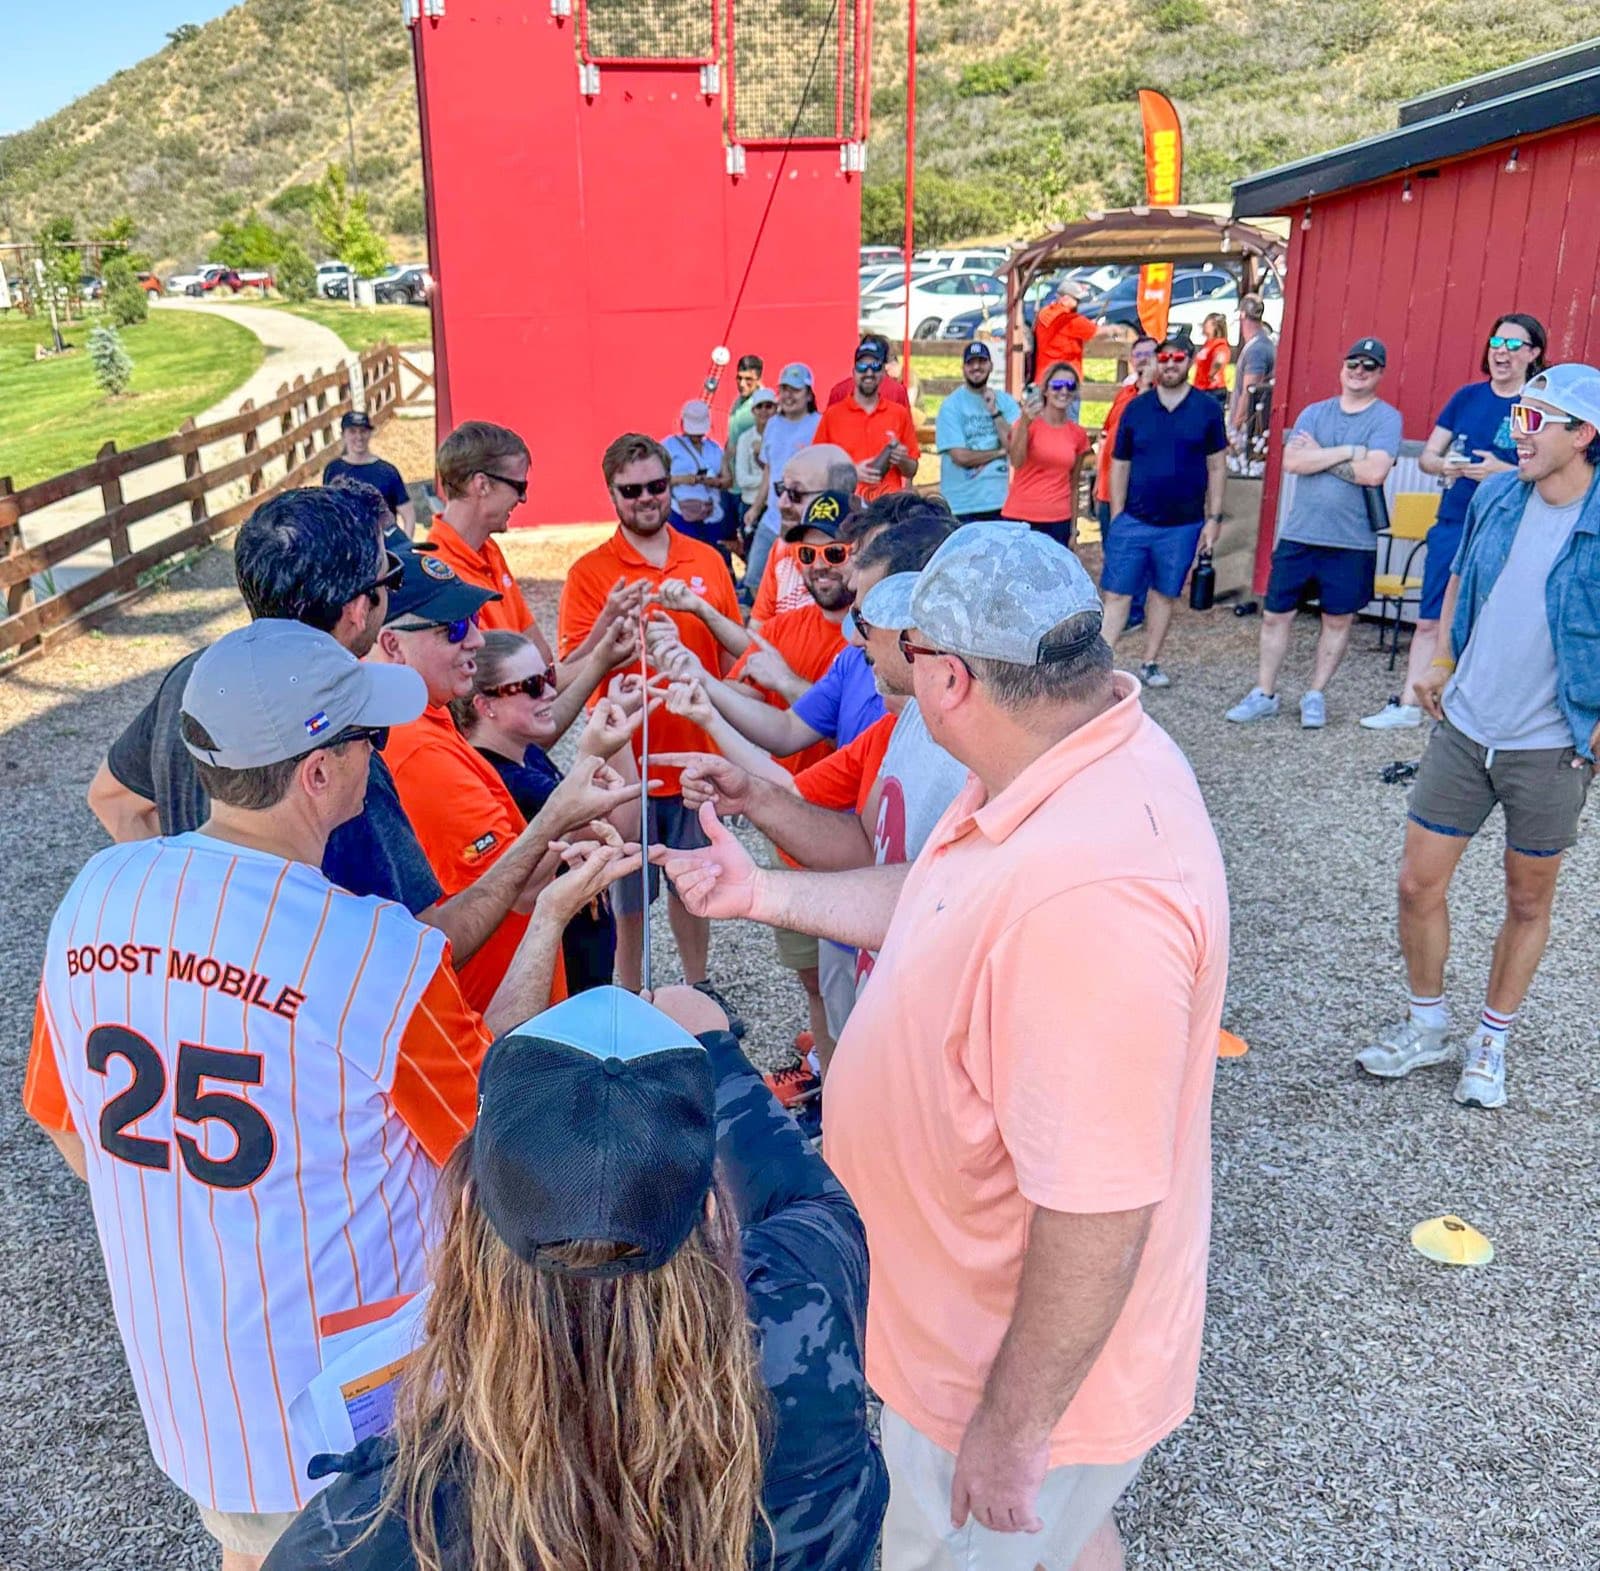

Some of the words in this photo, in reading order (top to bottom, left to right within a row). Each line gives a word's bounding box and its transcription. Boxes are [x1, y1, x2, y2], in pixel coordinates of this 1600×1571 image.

[476, 835, 494, 850] 24
[67, 943, 161, 977] BOOST
[169, 950, 307, 1021] MOBILE
[85, 1023, 278, 1192] 25
